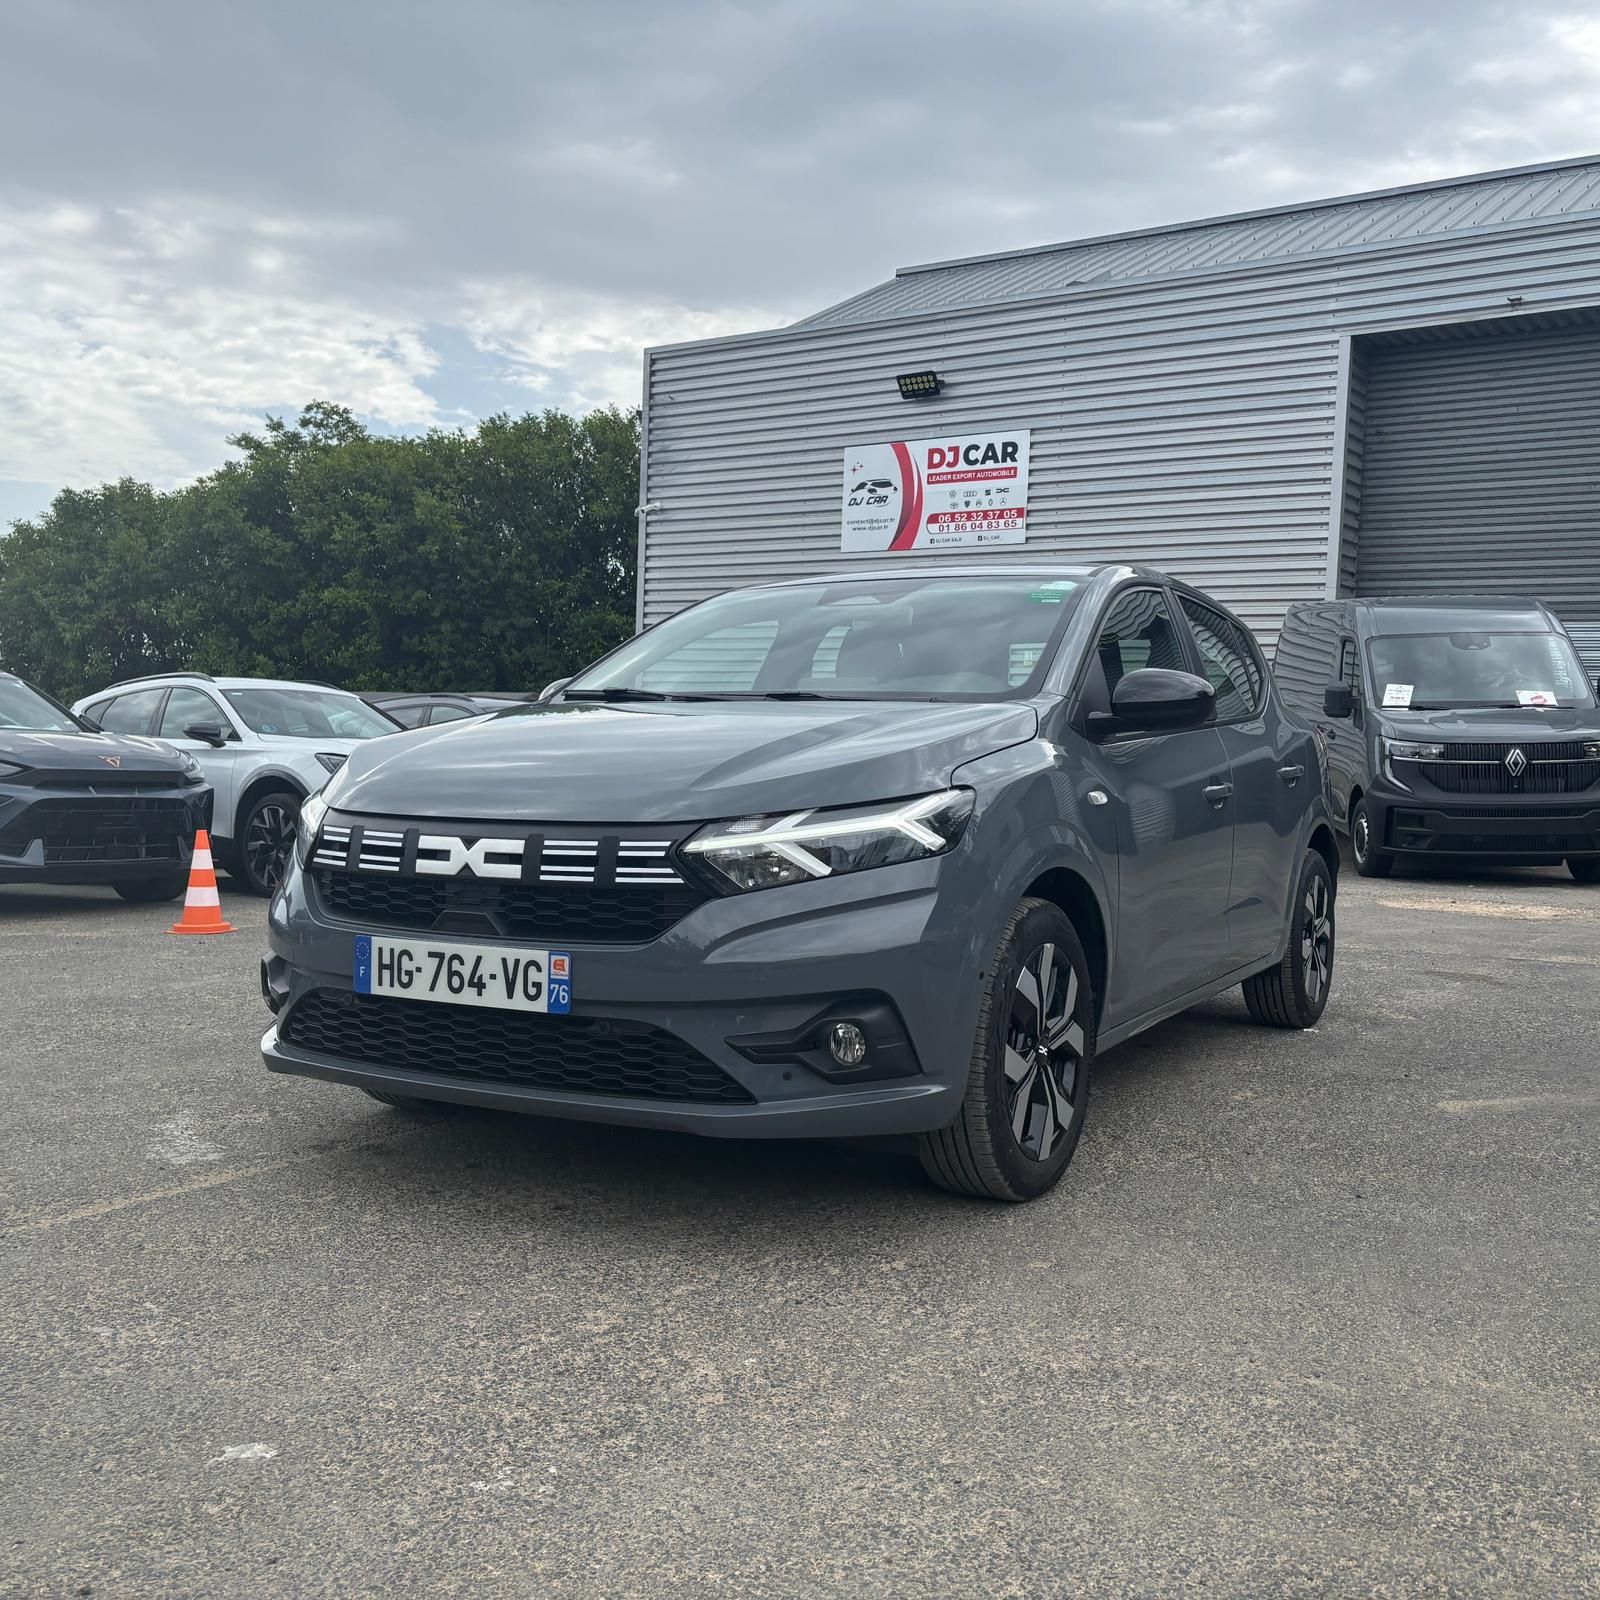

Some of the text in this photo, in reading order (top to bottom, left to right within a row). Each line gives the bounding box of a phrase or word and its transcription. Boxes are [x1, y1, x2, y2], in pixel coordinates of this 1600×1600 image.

[928, 469, 1015, 482] LEADER EXPORT AUTOMOBILE
[848, 495, 889, 507] DJ CAR
[938, 509, 1017, 523] 06 52 32 37 05
[938, 519, 1017, 532] 01 86 04 83 65
[359, 946, 569, 1004] F HG-764-VG 76
